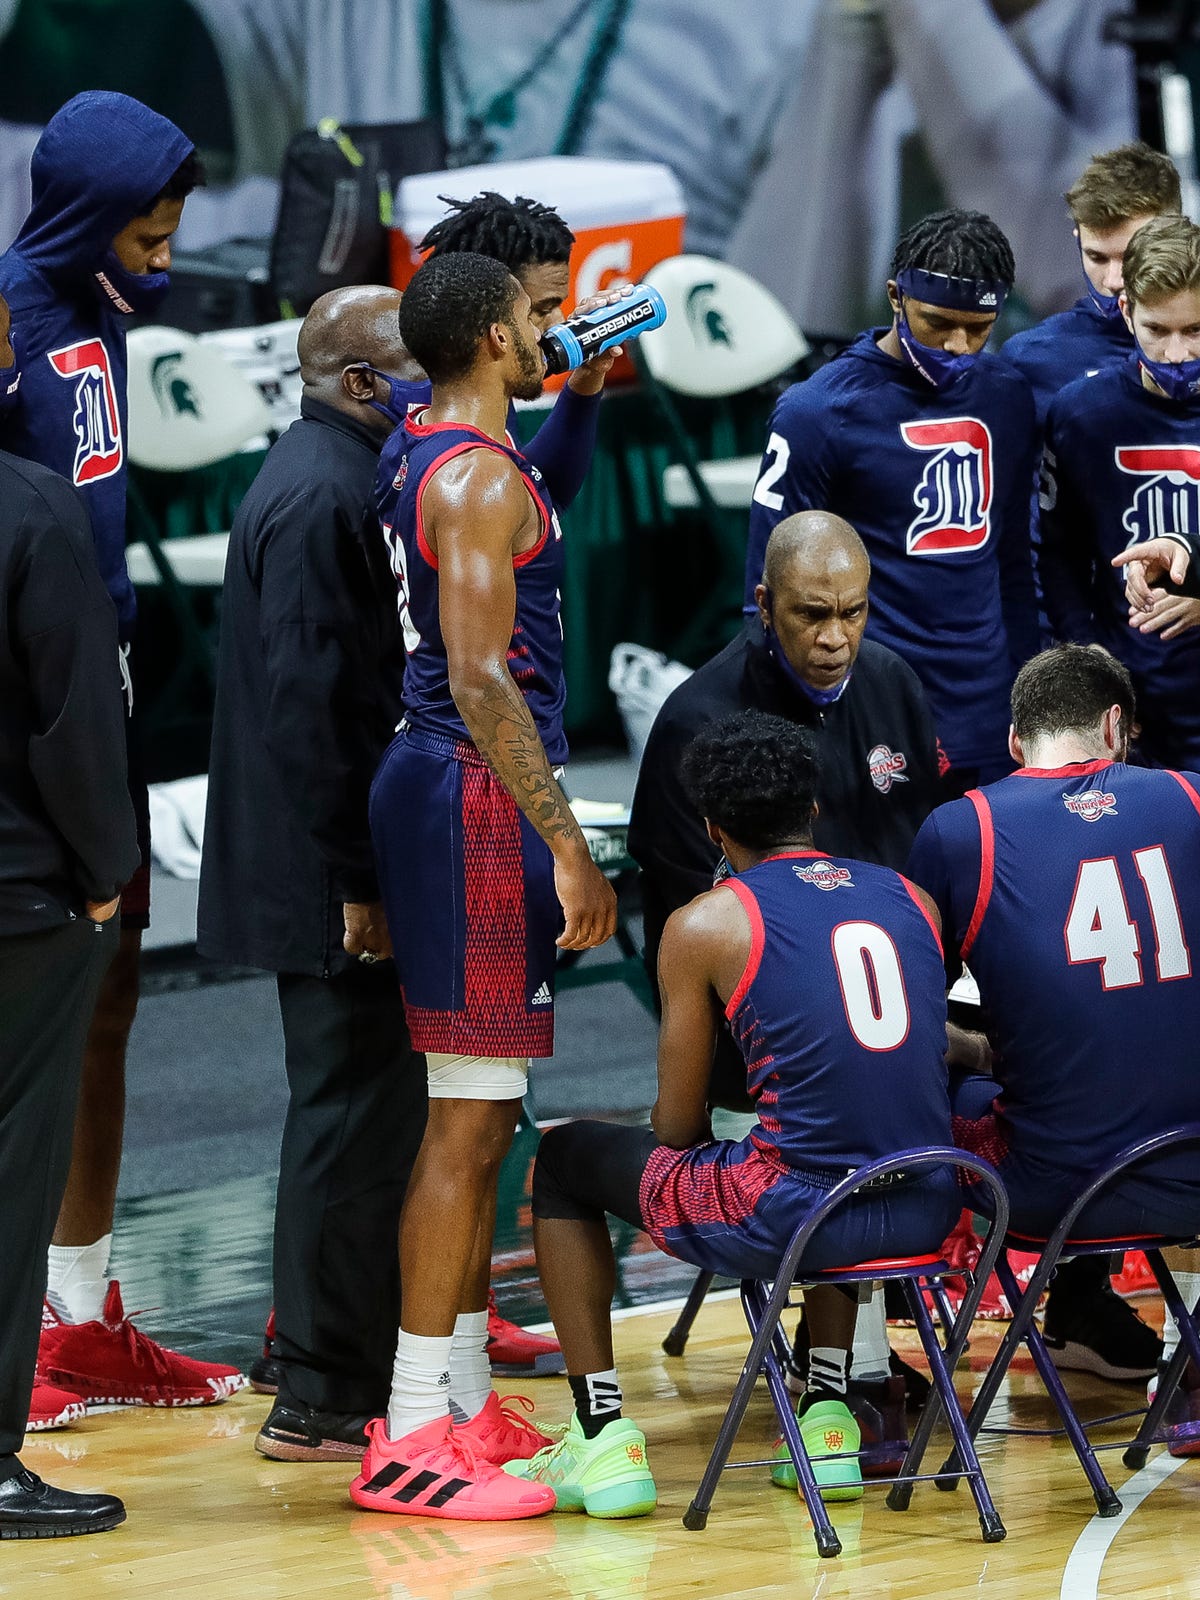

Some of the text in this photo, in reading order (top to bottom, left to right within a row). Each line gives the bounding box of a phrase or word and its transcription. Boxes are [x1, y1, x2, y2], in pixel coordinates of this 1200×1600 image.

[582, 301, 654, 346] POWERADE
[753, 431, 791, 511] 2
[870, 754, 906, 777] TANS
[519, 771, 568, 831] SKY
[1065, 794, 1116, 812] TITANS
[1063, 843, 1193, 992] 41
[531, 995, 553, 1005] adidas
[830, 919, 911, 1053] 0
